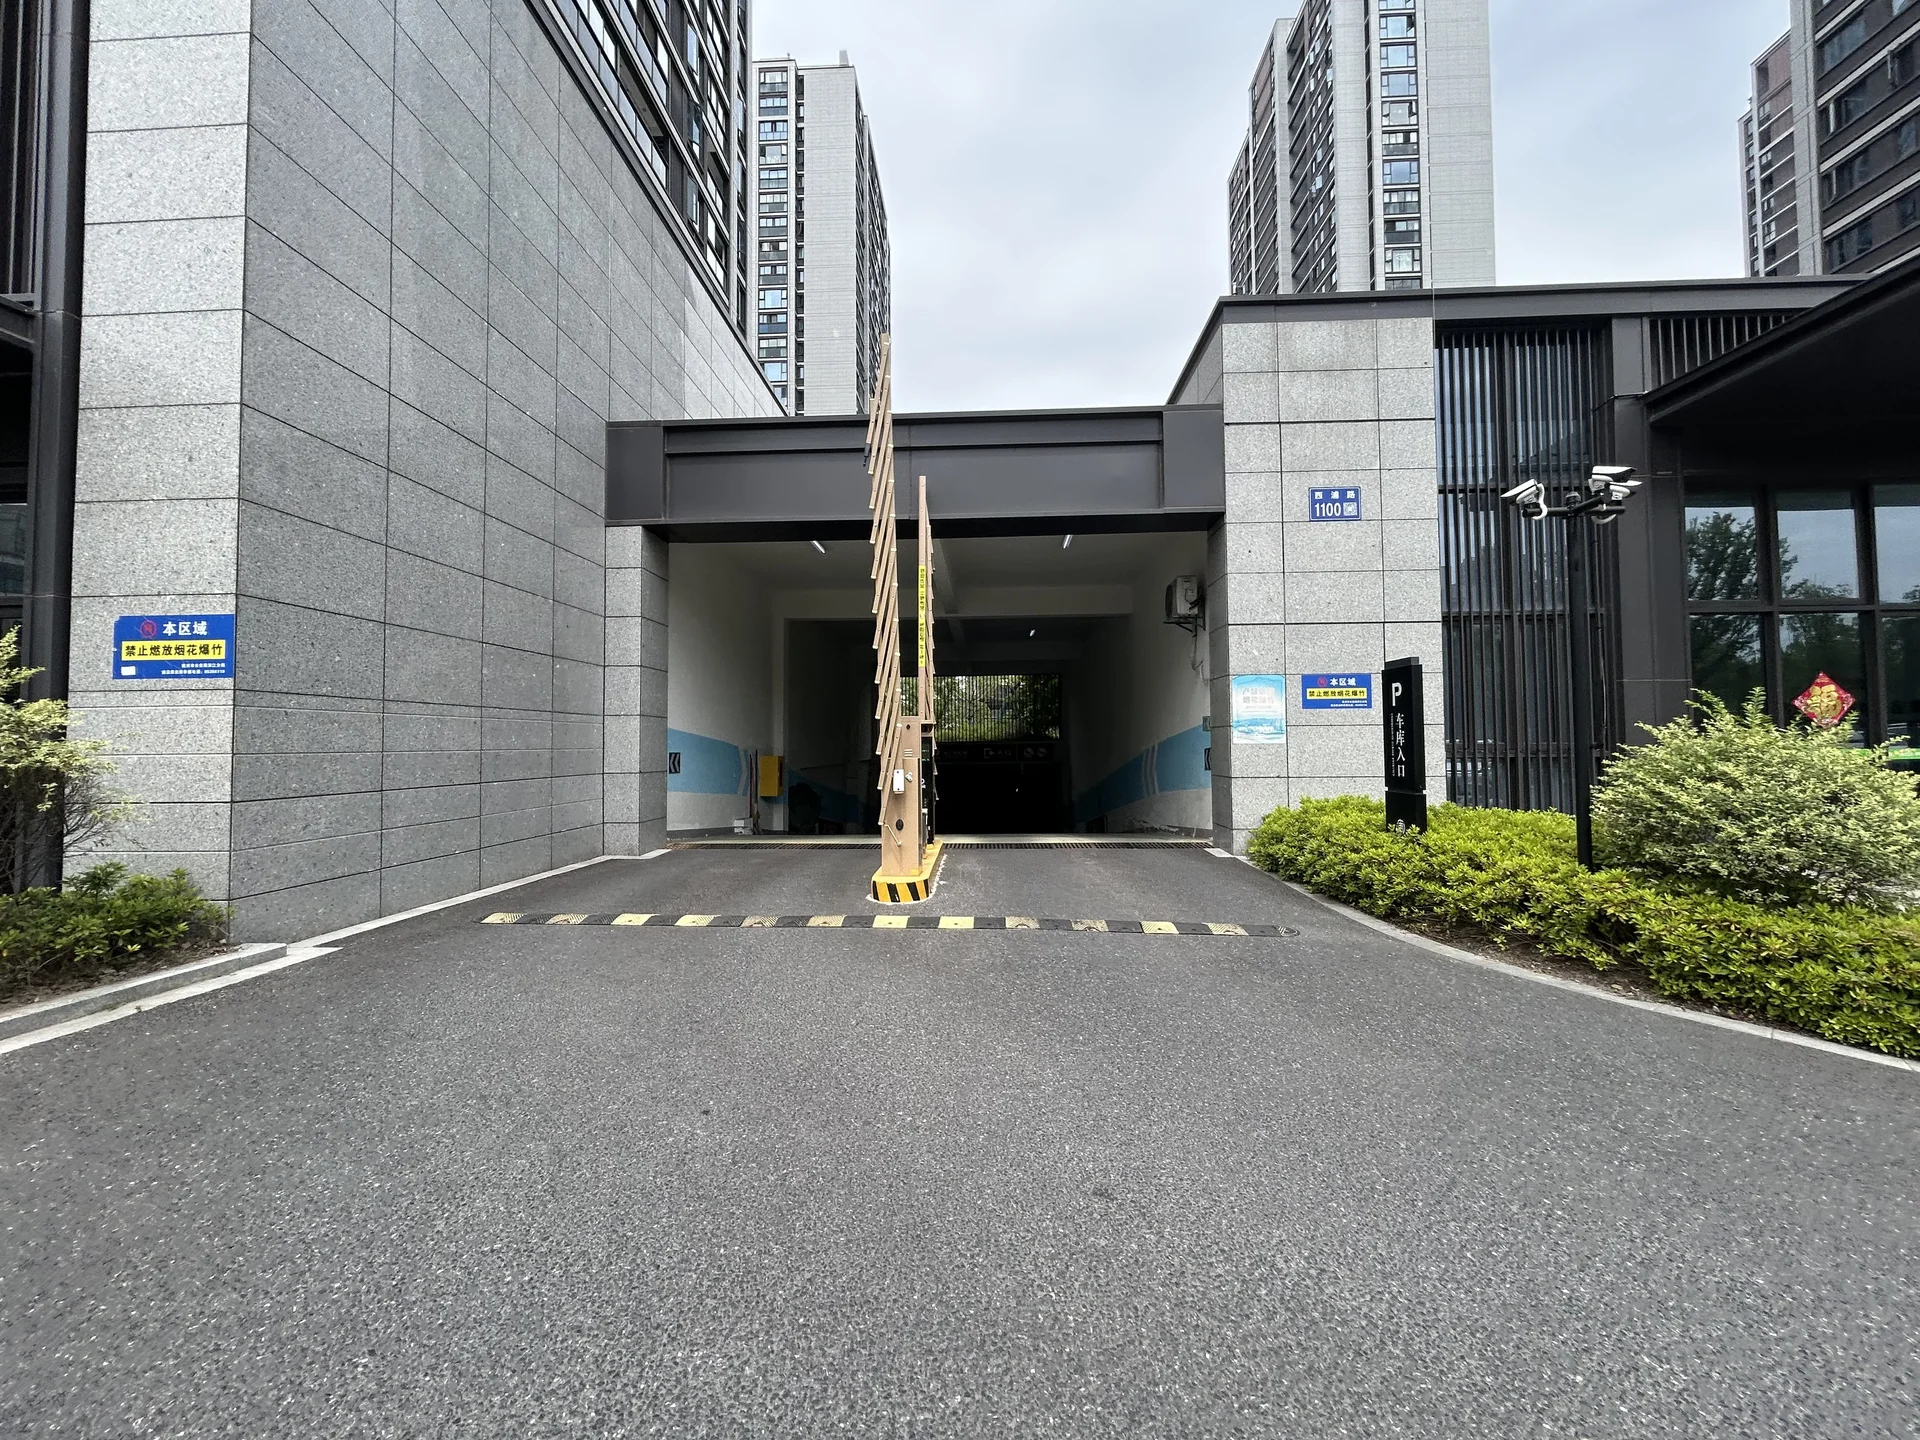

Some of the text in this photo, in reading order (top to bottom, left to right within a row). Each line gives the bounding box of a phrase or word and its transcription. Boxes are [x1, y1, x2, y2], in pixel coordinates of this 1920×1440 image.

[1314, 502, 1341, 517] 1100
[162, 620, 208, 637] 本区域
[125, 643, 223, 657] 禁止燃放烟花爆竹
[1329, 677, 1357, 687] 本区域
[1308, 689, 1366, 698] 禁止燃放烟花爆竹
[1391, 682, 1403, 707] P
[1395, 712, 1406, 778] 车库入口
